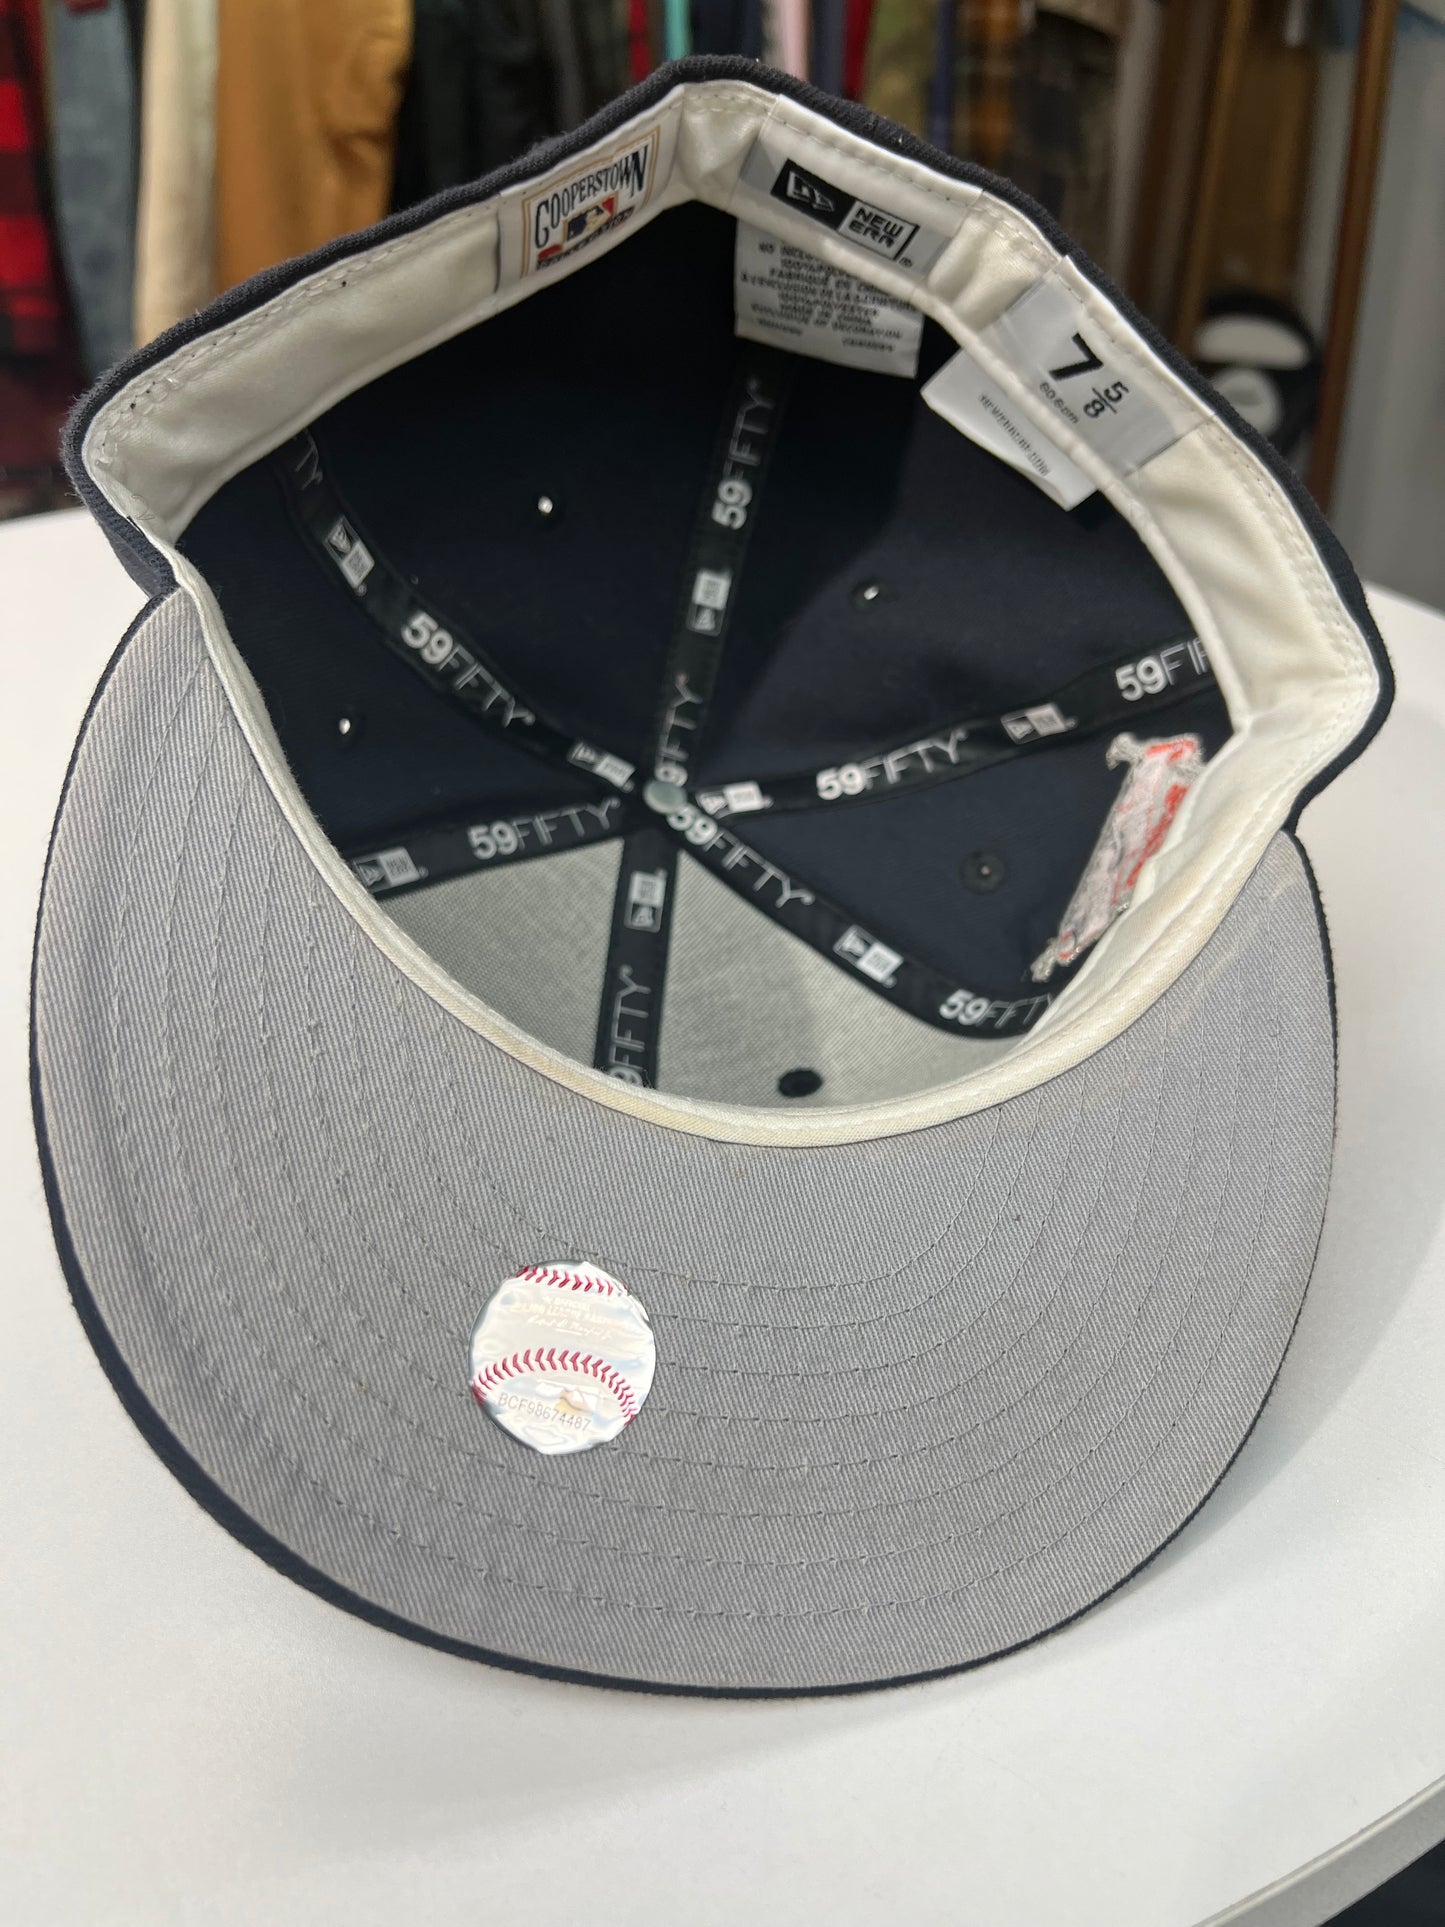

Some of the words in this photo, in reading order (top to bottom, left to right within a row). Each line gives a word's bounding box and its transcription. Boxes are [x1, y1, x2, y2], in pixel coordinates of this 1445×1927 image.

[535, 144, 649, 249] COOPERSTOWN
[855, 207, 904, 238] NEW
[848, 219, 896, 249] ERA
[1048, 332, 1104, 382] 7
[711, 386, 775, 530] 59FIFTY
[400, 610, 533, 728] 59FIFTY
[653, 680, 703, 788] 9FIFTY
[816, 730, 965, 801] 59FIFTY
[466, 800, 616, 861] 59FIFTY
[499, 1391, 592, 1432] BCF98674487
